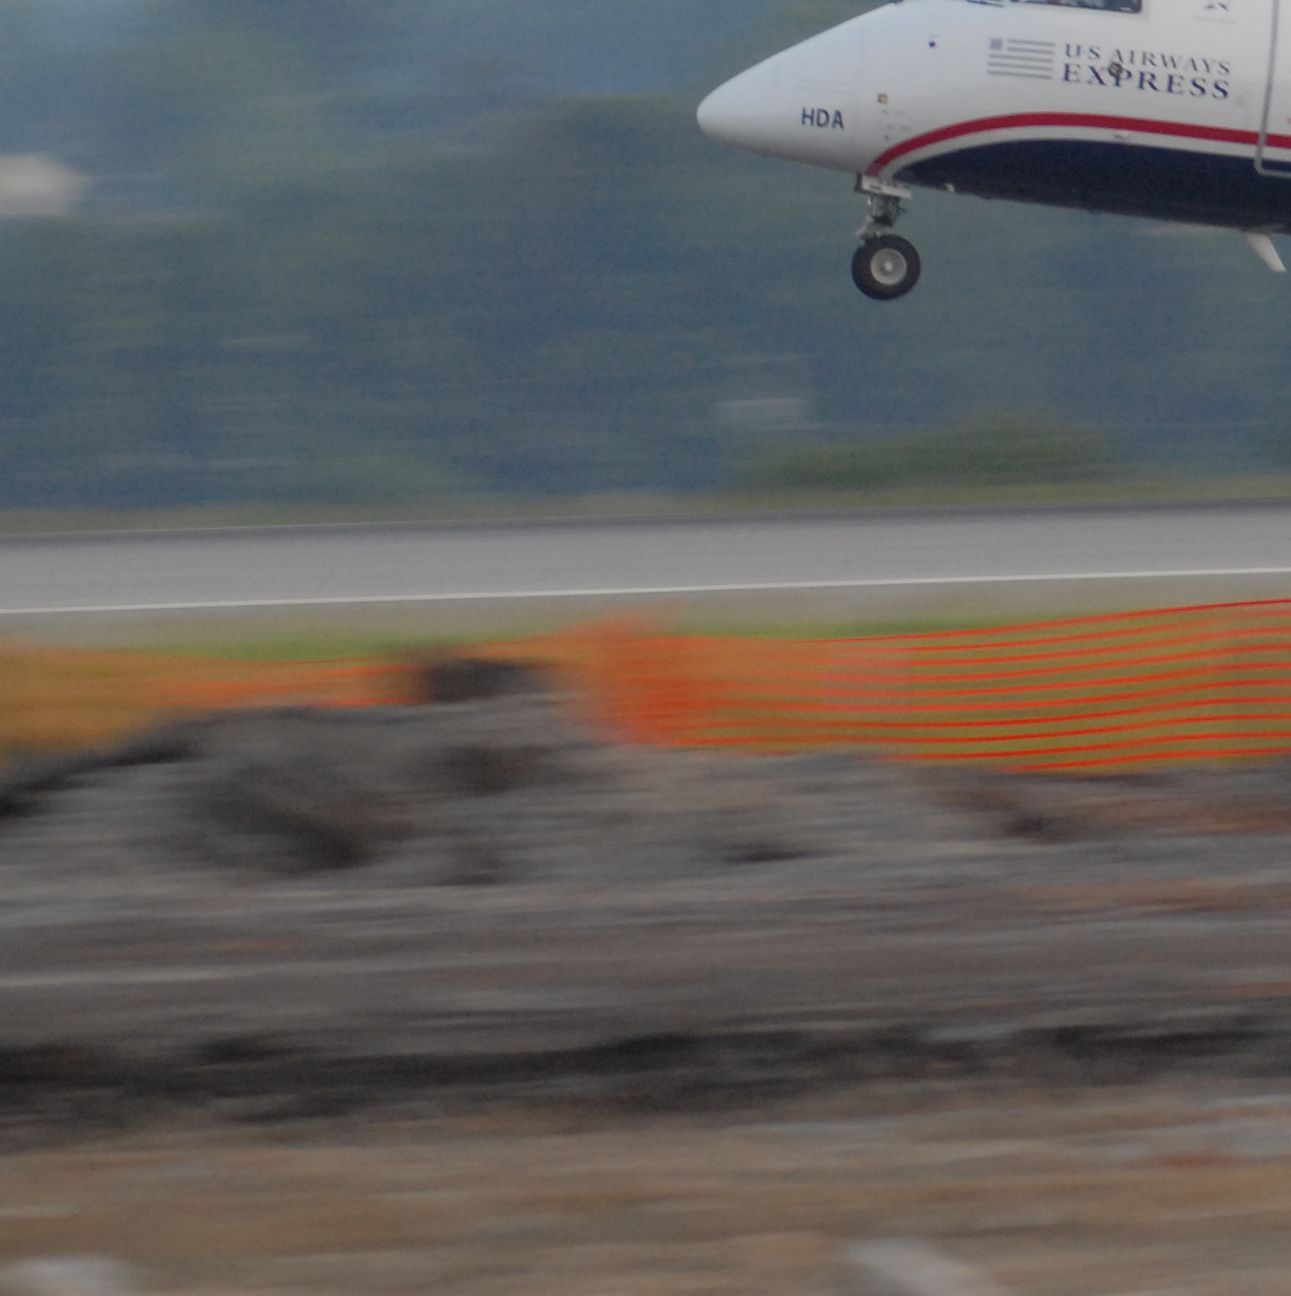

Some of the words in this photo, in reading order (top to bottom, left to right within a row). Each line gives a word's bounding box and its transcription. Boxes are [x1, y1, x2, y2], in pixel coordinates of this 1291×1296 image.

[1064, 43, 1101, 61] US
[1107, 48, 1231, 75] AIRWAYS
[1063, 63, 1230, 100] EXPRESS
[801, 107, 844, 130] HDA
